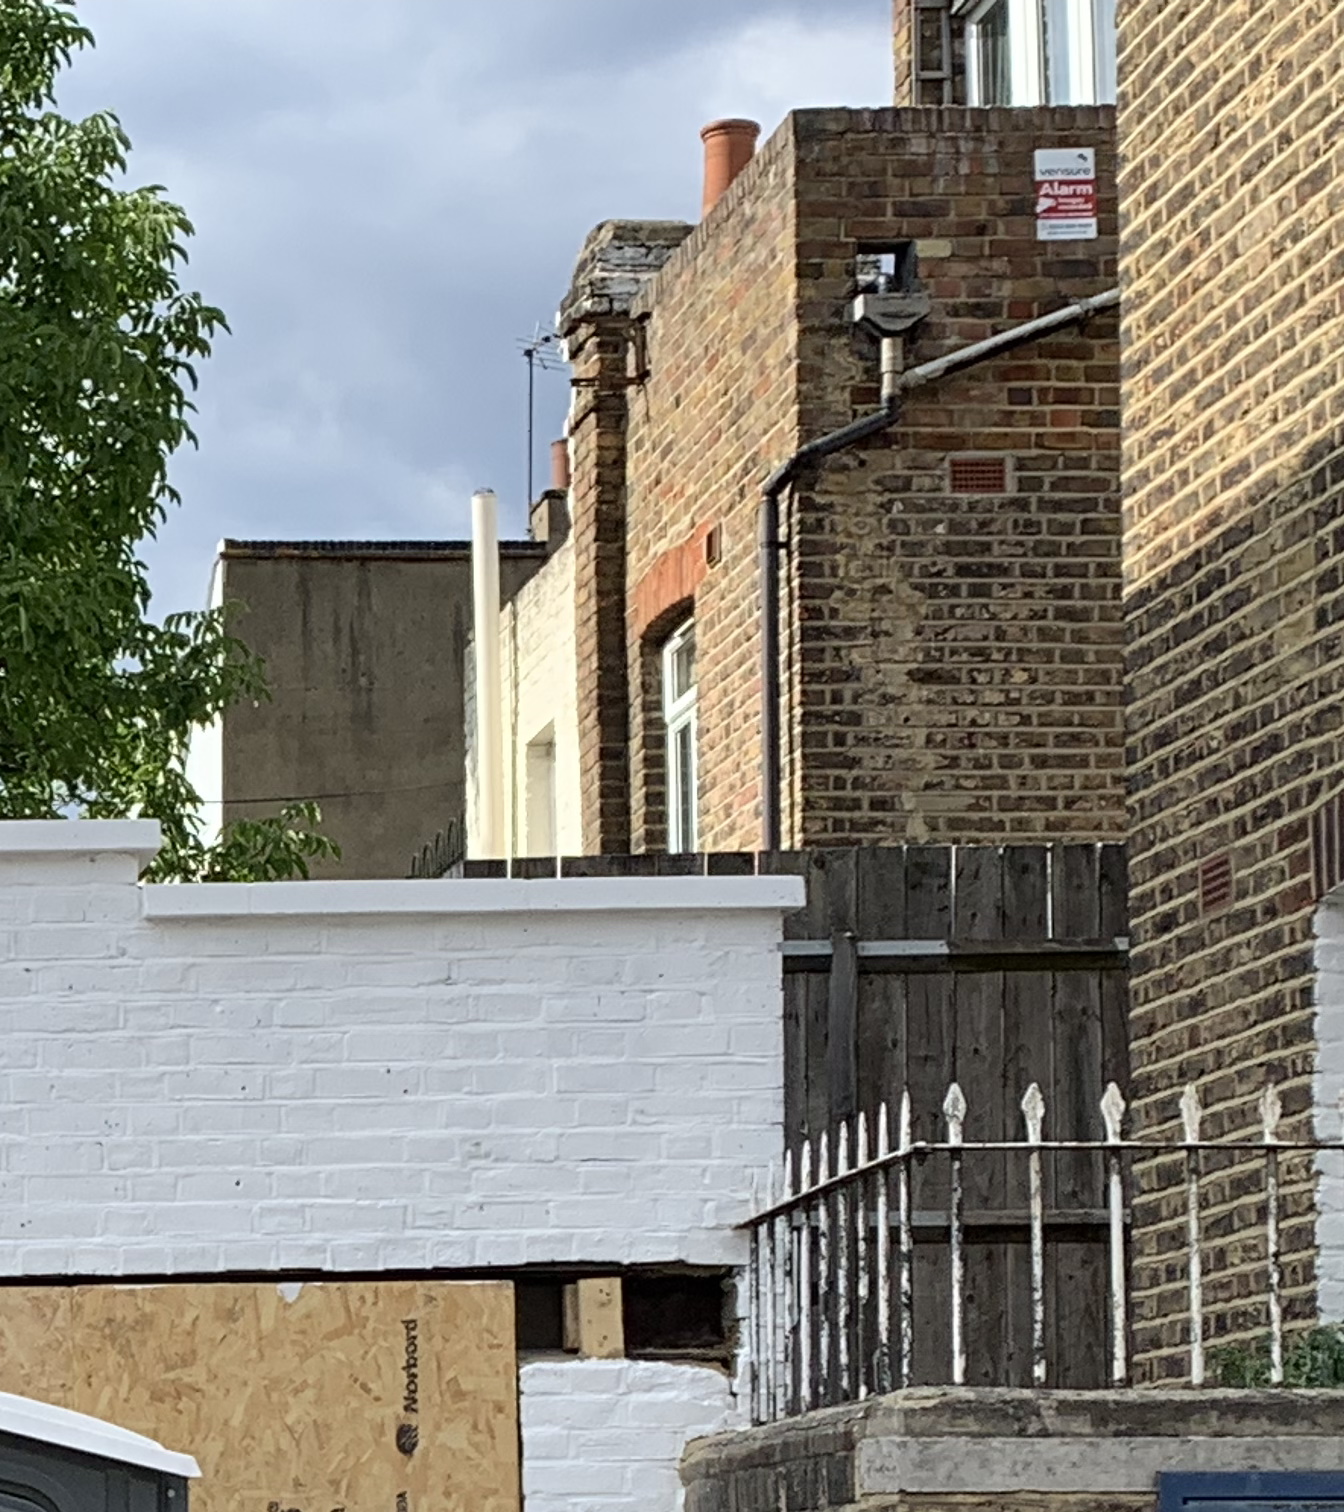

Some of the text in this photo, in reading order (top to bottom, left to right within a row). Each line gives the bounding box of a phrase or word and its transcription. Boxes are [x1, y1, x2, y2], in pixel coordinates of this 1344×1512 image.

[1039, 167, 1092, 176] verisure
[1039, 182, 1093, 196] Alarm
[400, 1317, 418, 1413] Norbord
